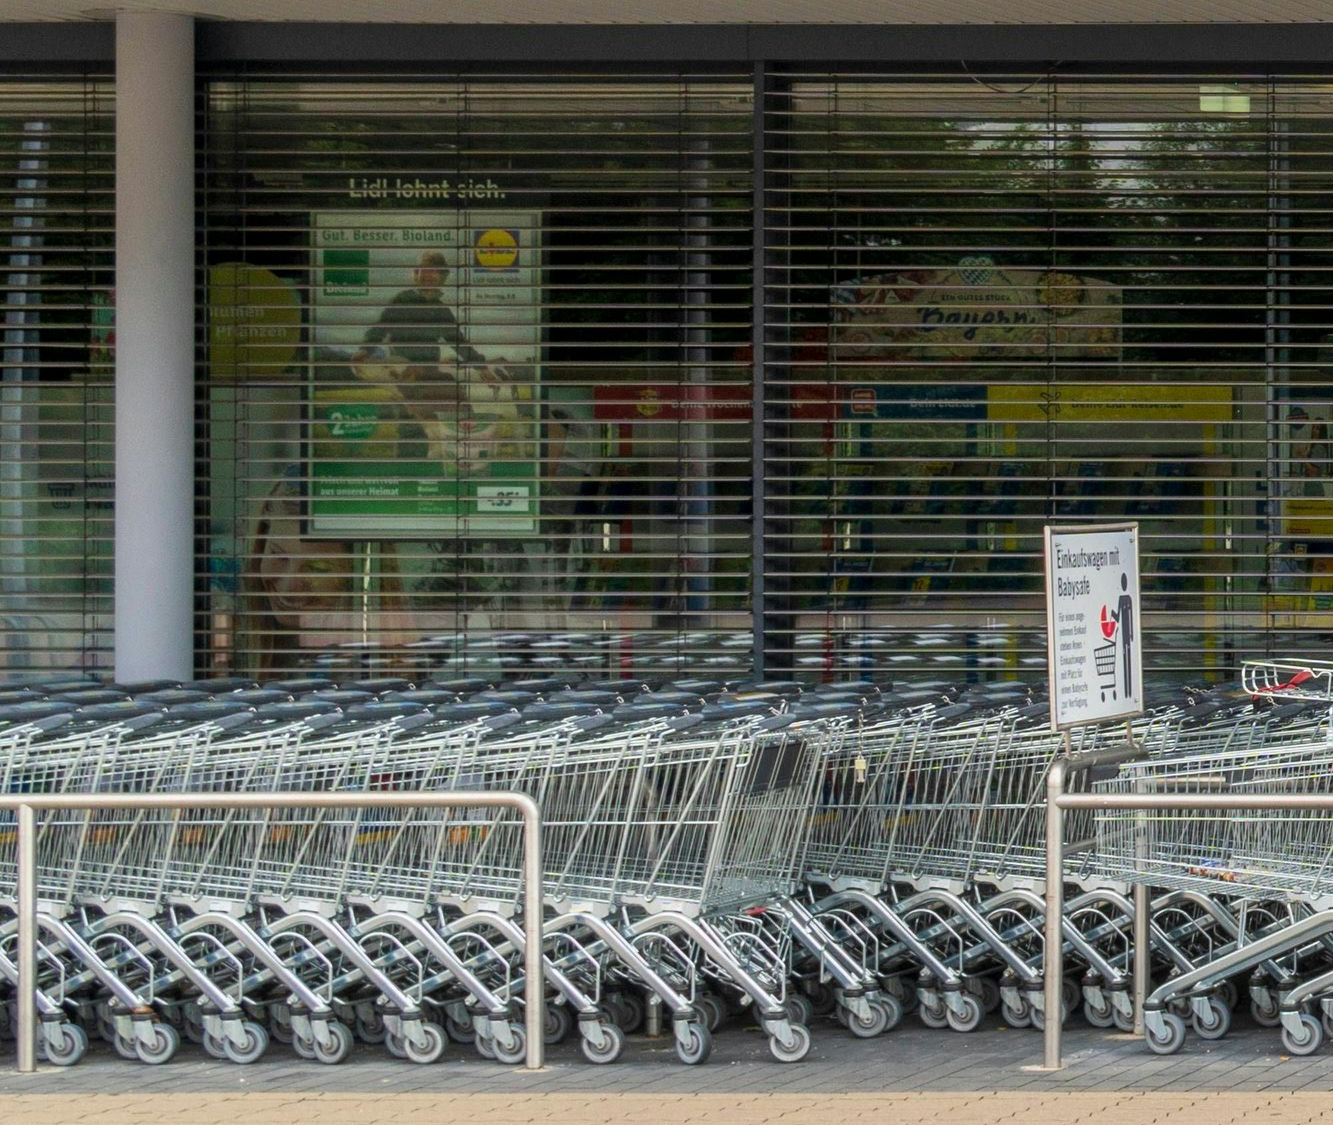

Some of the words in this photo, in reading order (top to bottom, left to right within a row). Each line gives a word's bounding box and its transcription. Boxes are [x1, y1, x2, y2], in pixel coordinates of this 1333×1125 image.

[350, 179, 388, 198] Lidl
[396, 179, 449, 198] lohnt
[457, 179, 506, 199] sich.
[322, 230, 349, 243] Gut.
[353, 230, 398, 243] Besser.
[402, 230, 456, 243] Bioland.
[1057, 548, 1108, 571] Einkaufswagen
[1109, 546, 1120, 566] mit
[1058, 576, 1091, 600] Babysafe
